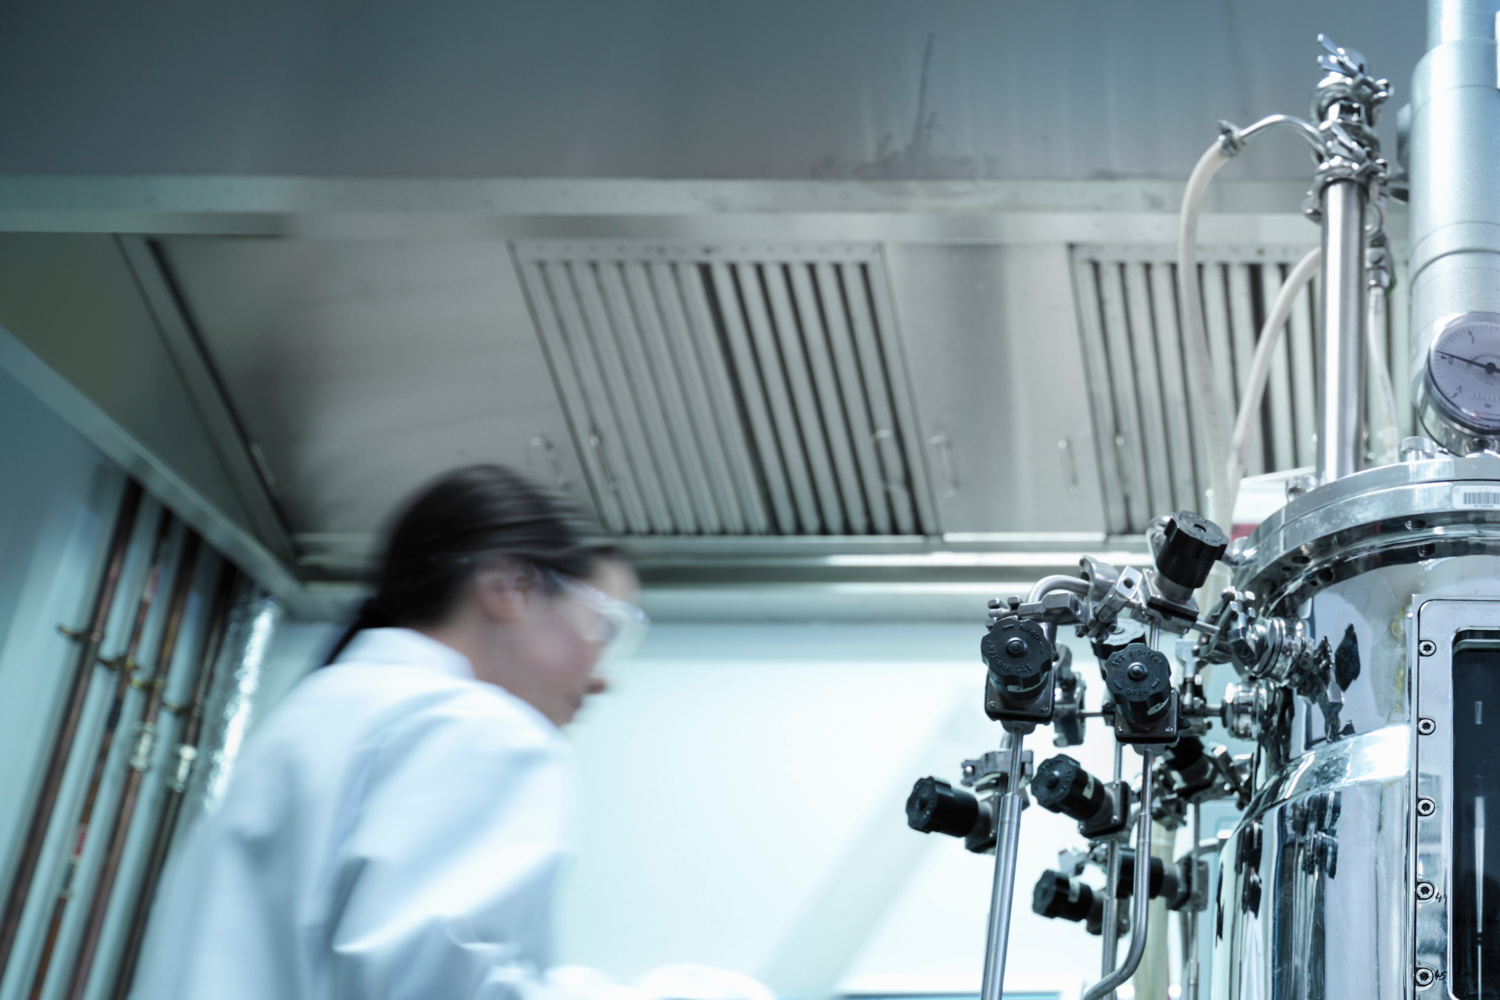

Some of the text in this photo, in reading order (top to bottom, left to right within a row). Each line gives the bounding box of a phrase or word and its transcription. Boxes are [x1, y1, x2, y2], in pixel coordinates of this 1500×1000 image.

[1019, 623, 1040, 640] OPEN
[1125, 687, 1149, 697] OPEN
[1435, 892, 1448, 906] 49
[1434, 969, 1447, 981] 45
